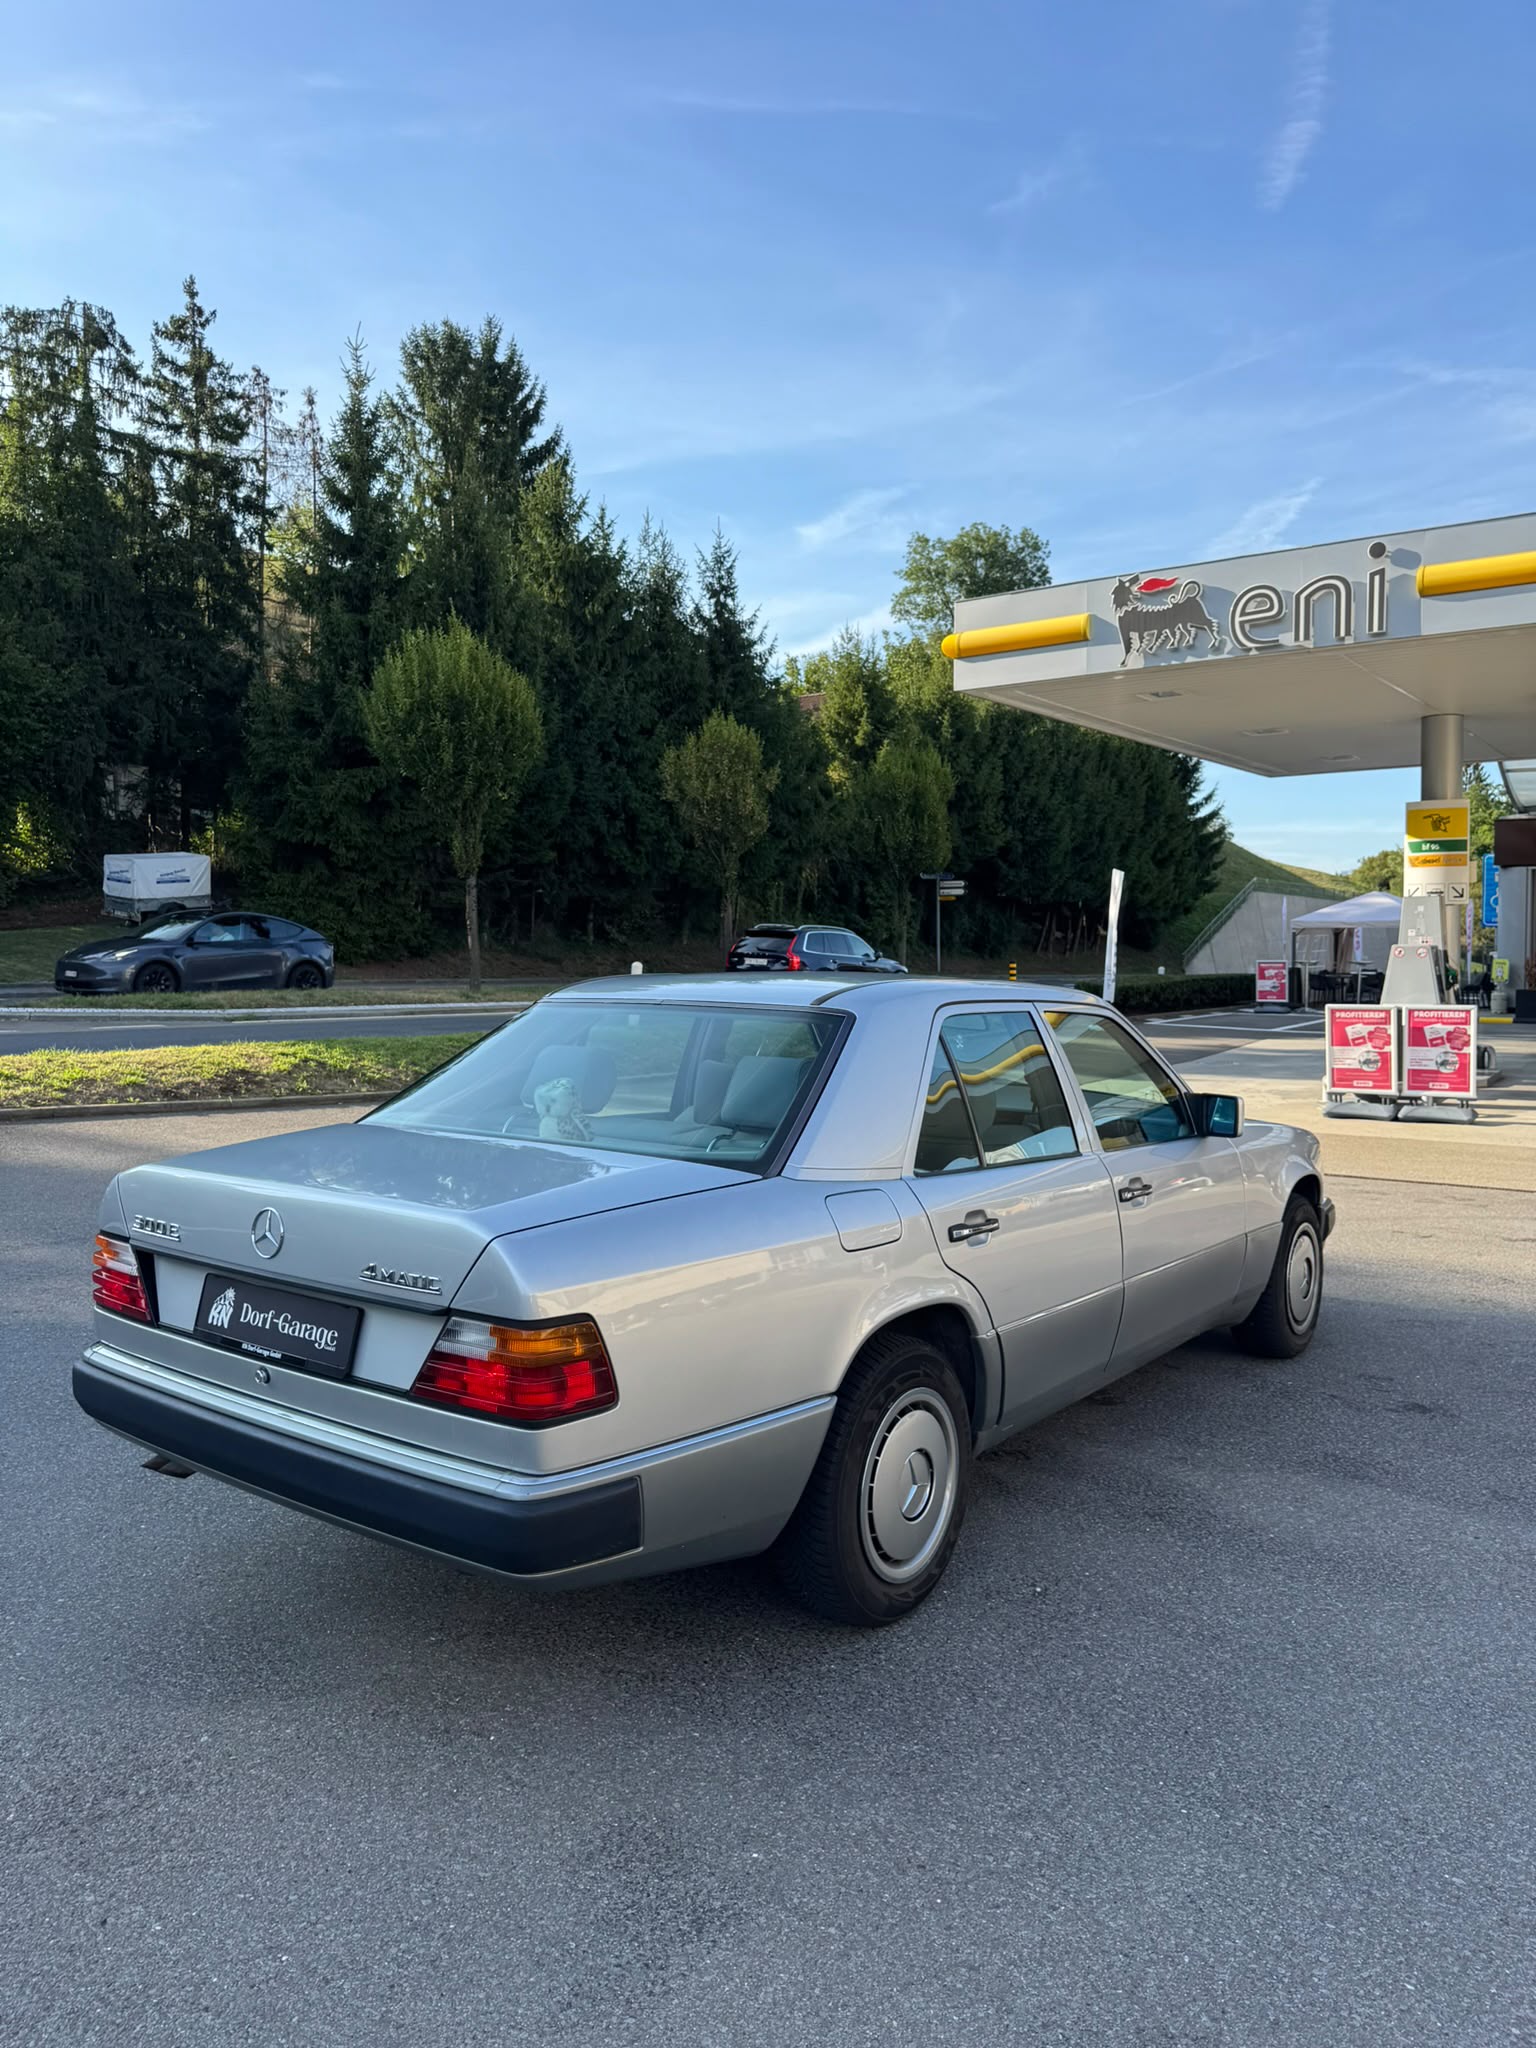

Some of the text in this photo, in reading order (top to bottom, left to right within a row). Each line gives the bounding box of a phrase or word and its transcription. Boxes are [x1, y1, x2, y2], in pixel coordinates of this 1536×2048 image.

[1229, 541, 1387, 649] eni
[1335, 1011, 1386, 1019] PROFITIEREN
[1413, 1010, 1466, 1018] PROFITIEREN
[240, 1302, 339, 1350] Dorf-Garage
